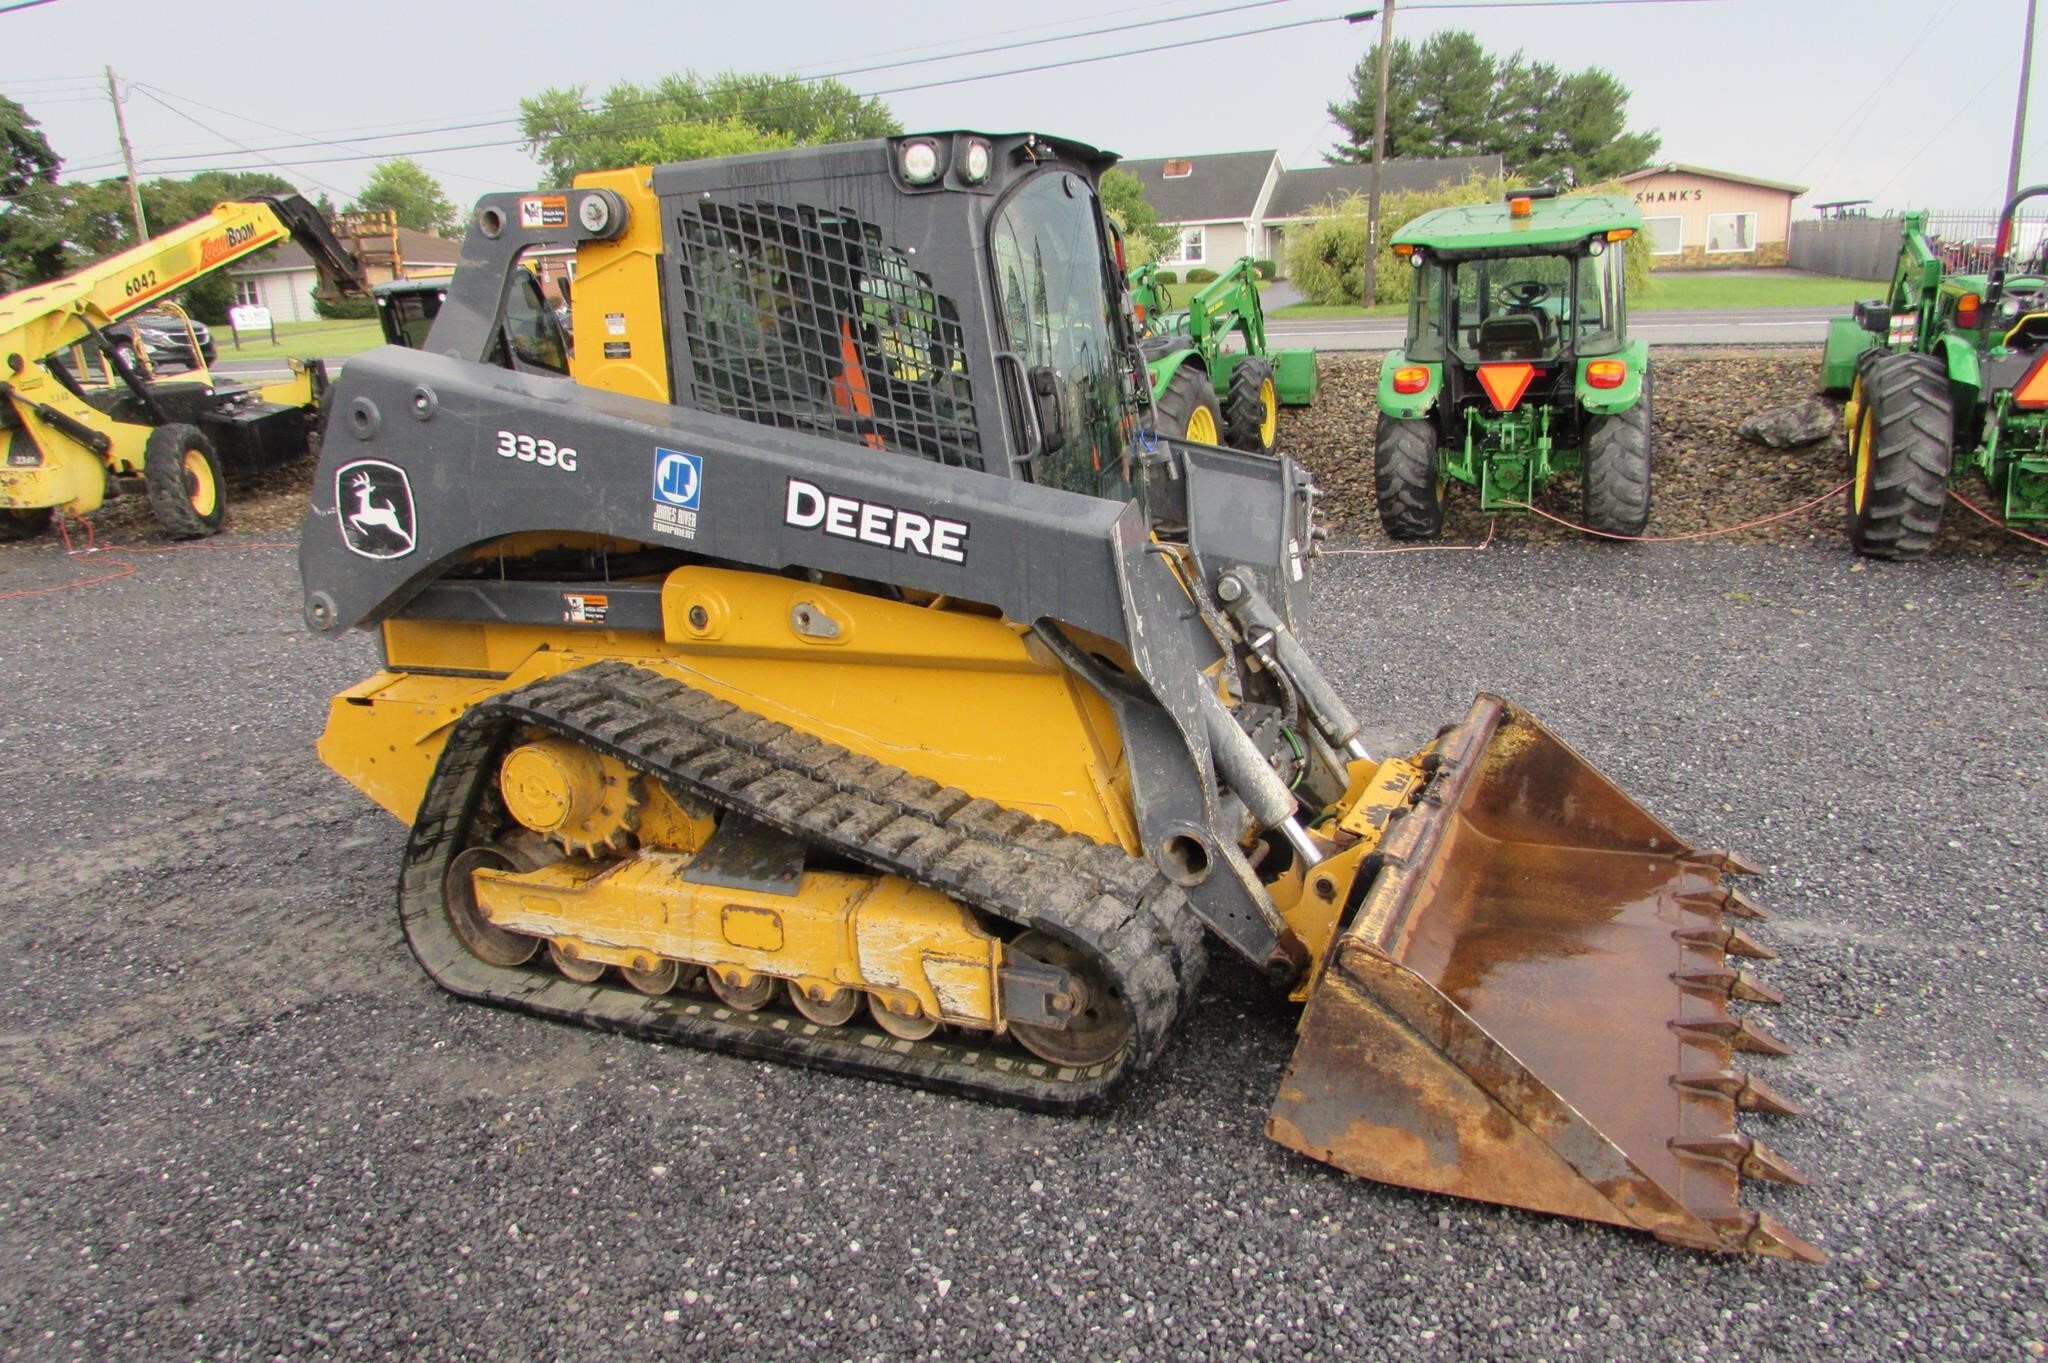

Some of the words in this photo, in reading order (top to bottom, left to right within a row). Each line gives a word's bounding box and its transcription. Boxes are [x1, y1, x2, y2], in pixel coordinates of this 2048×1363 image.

[1636, 190, 1702, 204] SHANK'S
[125, 270, 157, 296] 6042
[497, 430, 577, 472] 333G
[653, 504, 677, 523] JAMES
[677, 508, 697, 528] RIVER
[786, 479, 968, 563] DEERE
[652, 521, 696, 540] EQUIPMENT
